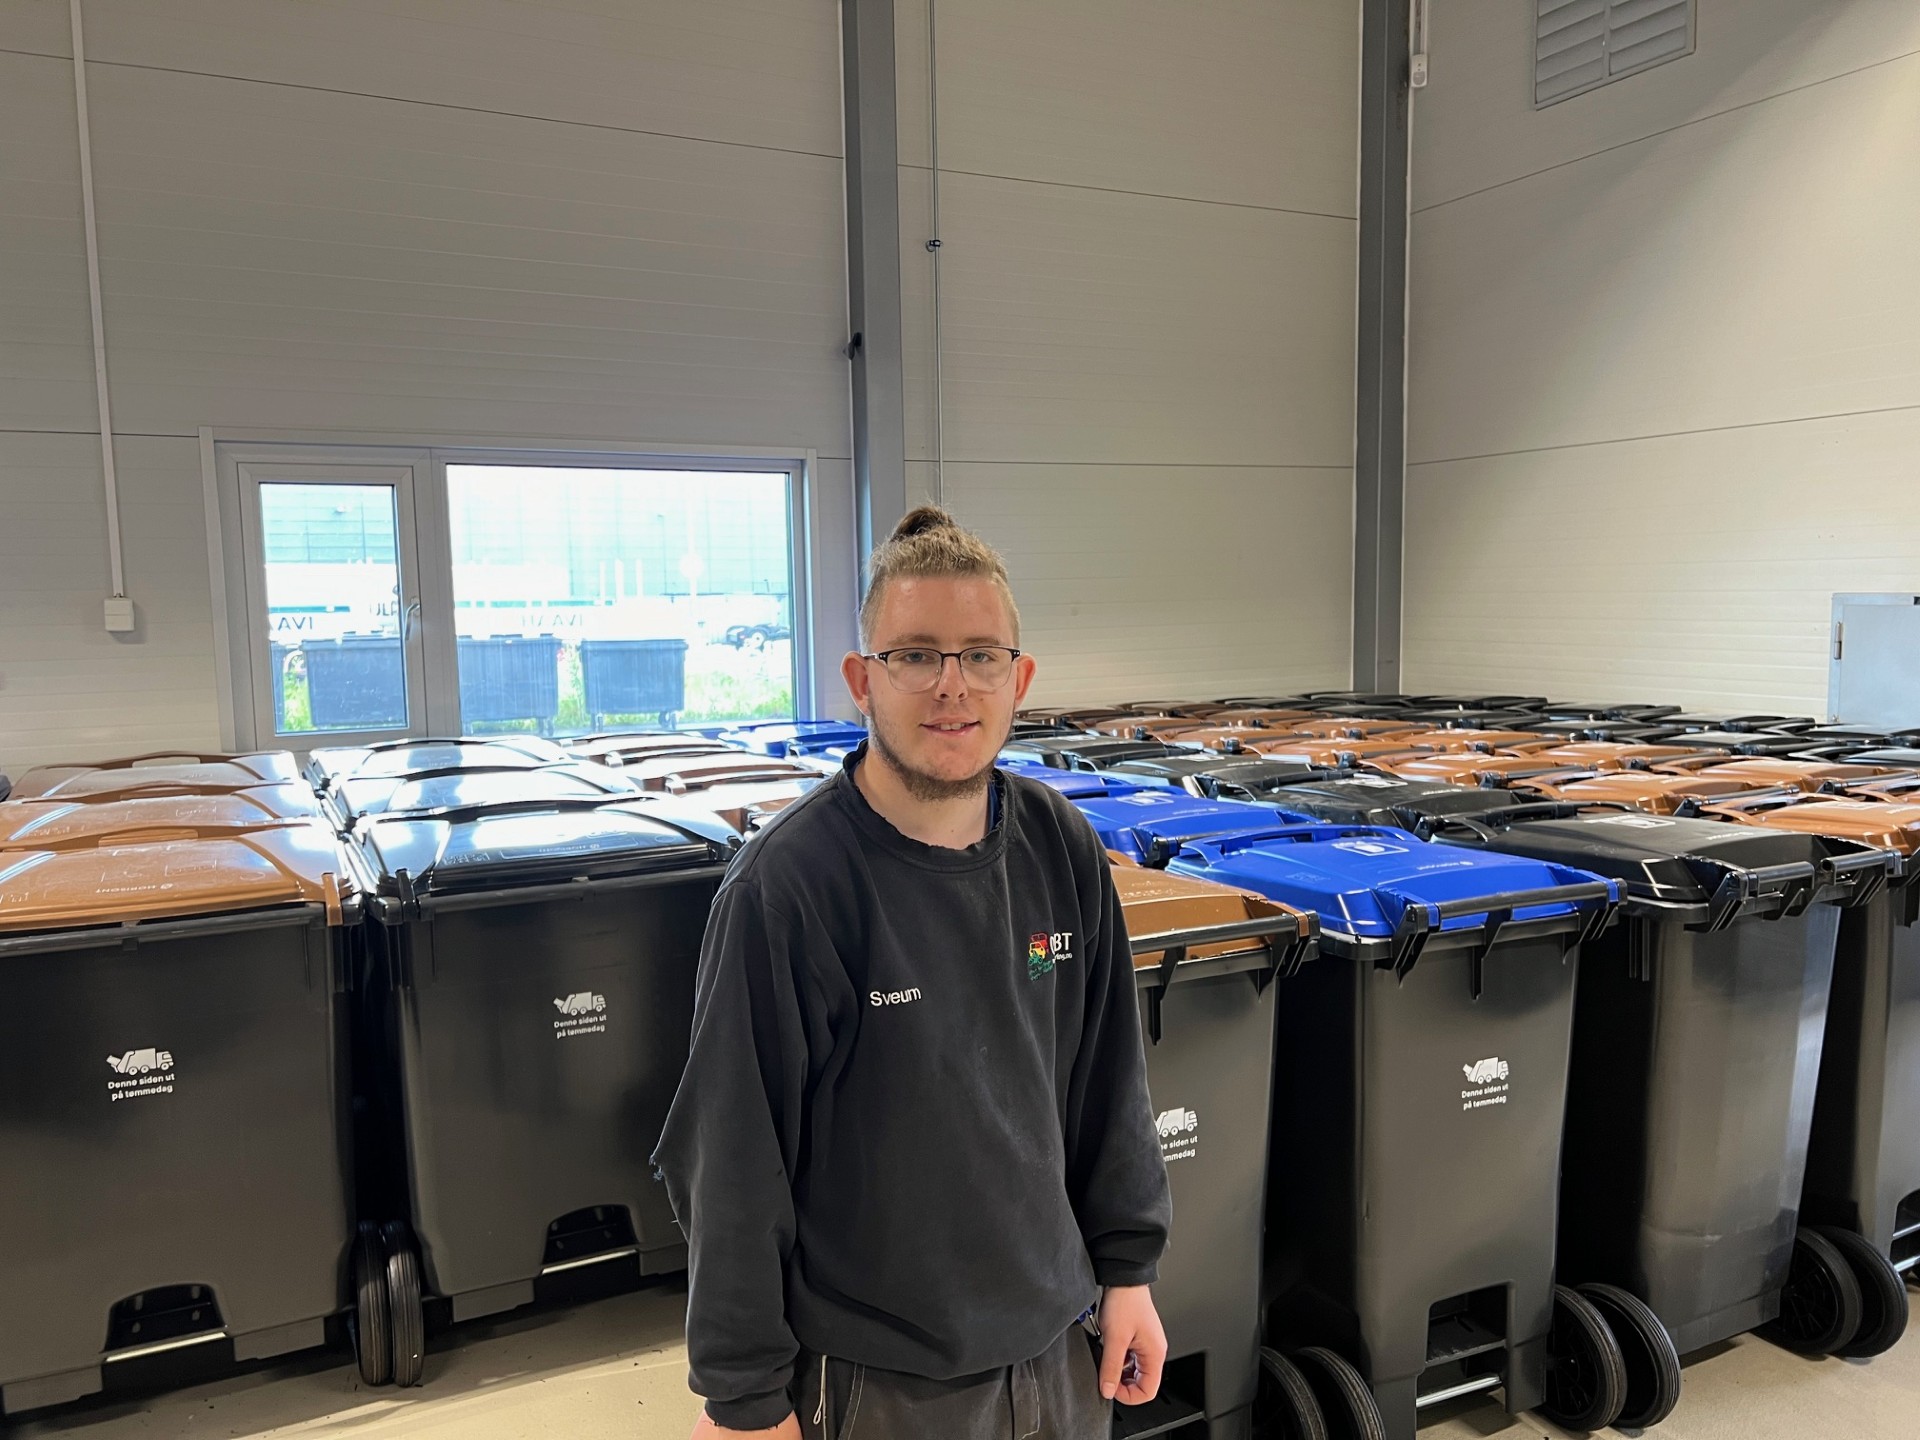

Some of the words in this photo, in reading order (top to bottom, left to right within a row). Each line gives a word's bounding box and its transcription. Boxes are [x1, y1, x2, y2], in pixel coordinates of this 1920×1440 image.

[870, 987, 922, 1006] Sveum
[554, 1019, 577, 1028] Denne
[579, 1016, 598, 1025] siden
[557, 1029, 567, 1039] på
[567, 1024, 605, 1036] tømmedag
[108, 1079, 138, 1090] Denne
[139, 1075, 164, 1085] siden
[165, 1073, 175, 1081] ut
[111, 1090, 124, 1101] på
[125, 1085, 173, 1098] tømmedag
[1461, 1089, 1483, 1099] Denne
[1484, 1085, 1501, 1094] siden
[1502, 1083, 1509, 1091] ut
[1463, 1100, 1472, 1111] på
[1473, 1095, 1507, 1108] tømmedag
[1169, 1139, 1189, 1149] siden
[1190, 1135, 1198, 1144] ut
[1164, 1148, 1196, 1162] mmedag
